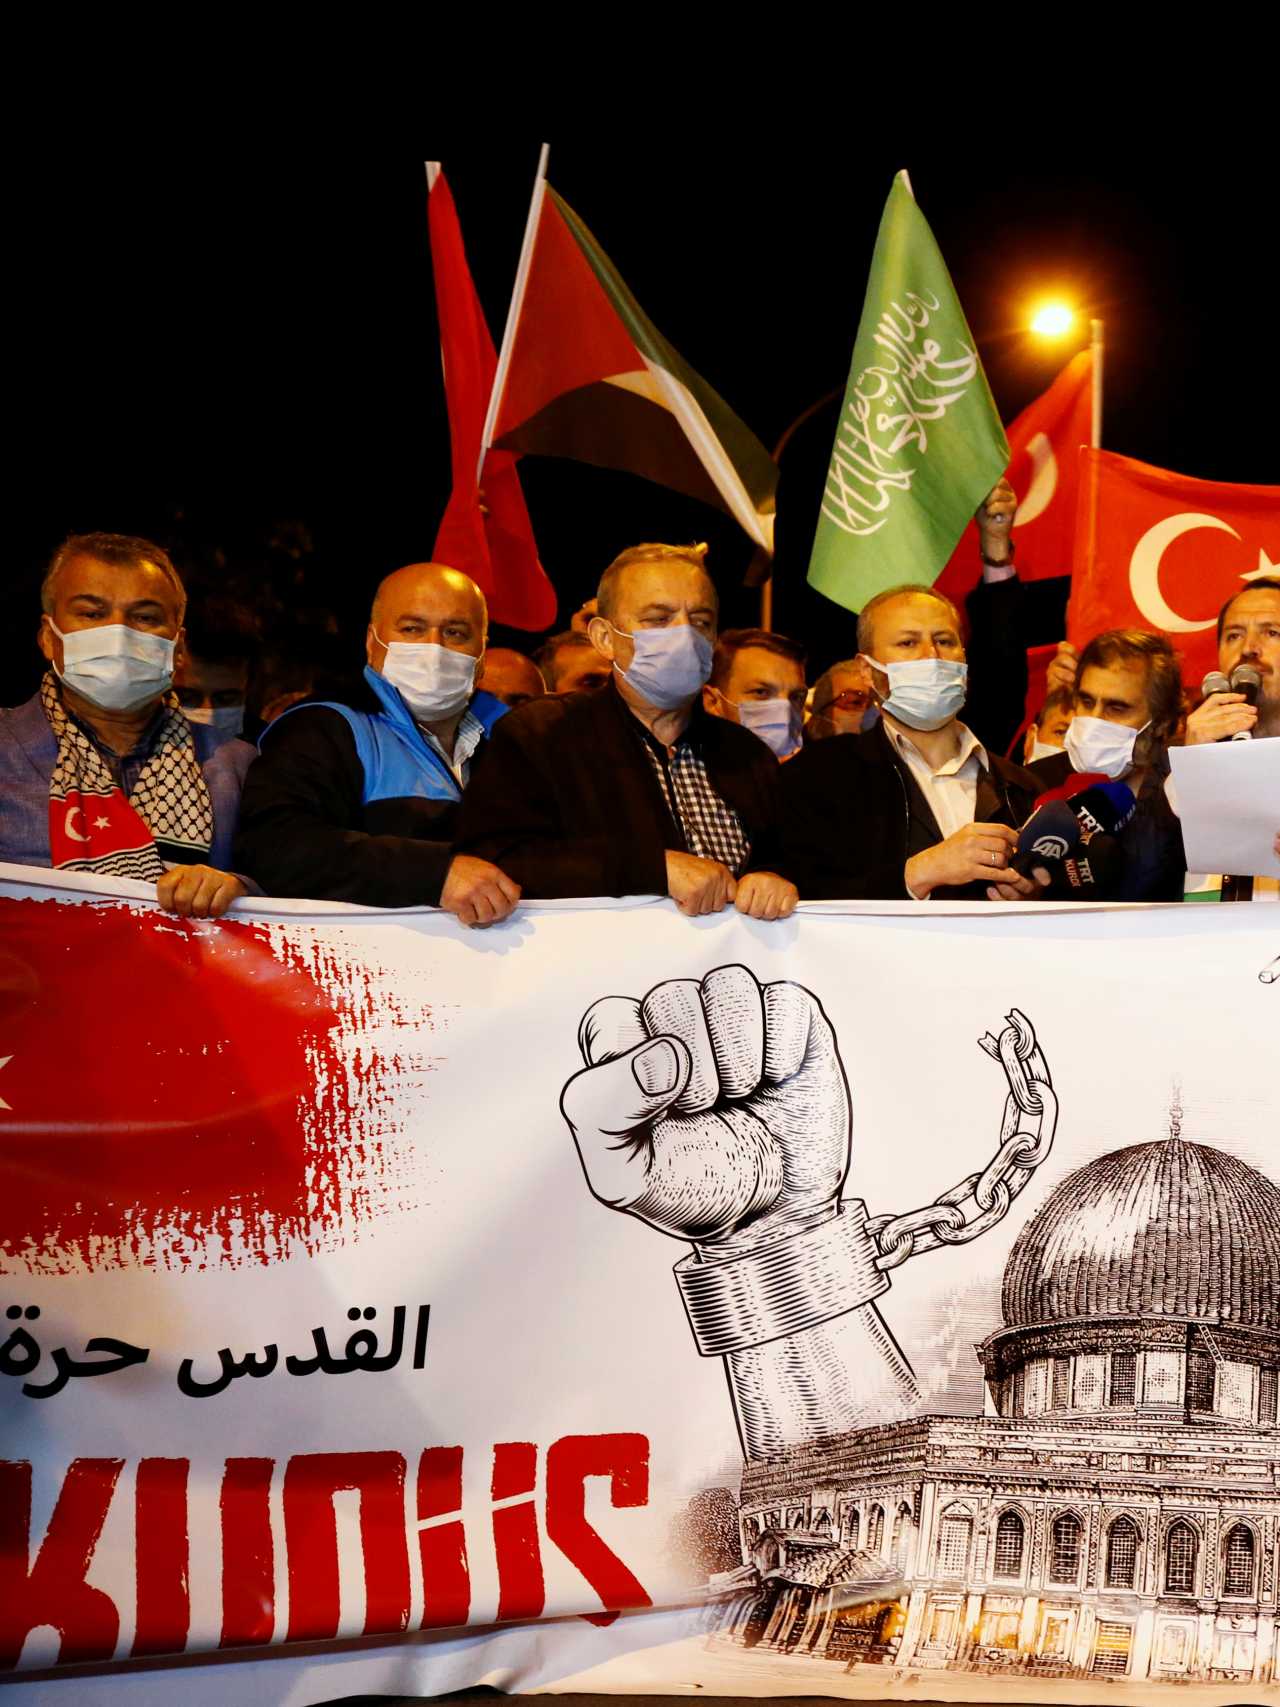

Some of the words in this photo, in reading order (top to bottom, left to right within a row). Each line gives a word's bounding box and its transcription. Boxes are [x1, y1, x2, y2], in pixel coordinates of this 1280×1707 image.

[1077, 806, 1104, 833] TRT
[0, 1304, 150, 1400] حرة
[178, 1304, 431, 1399] القدس
